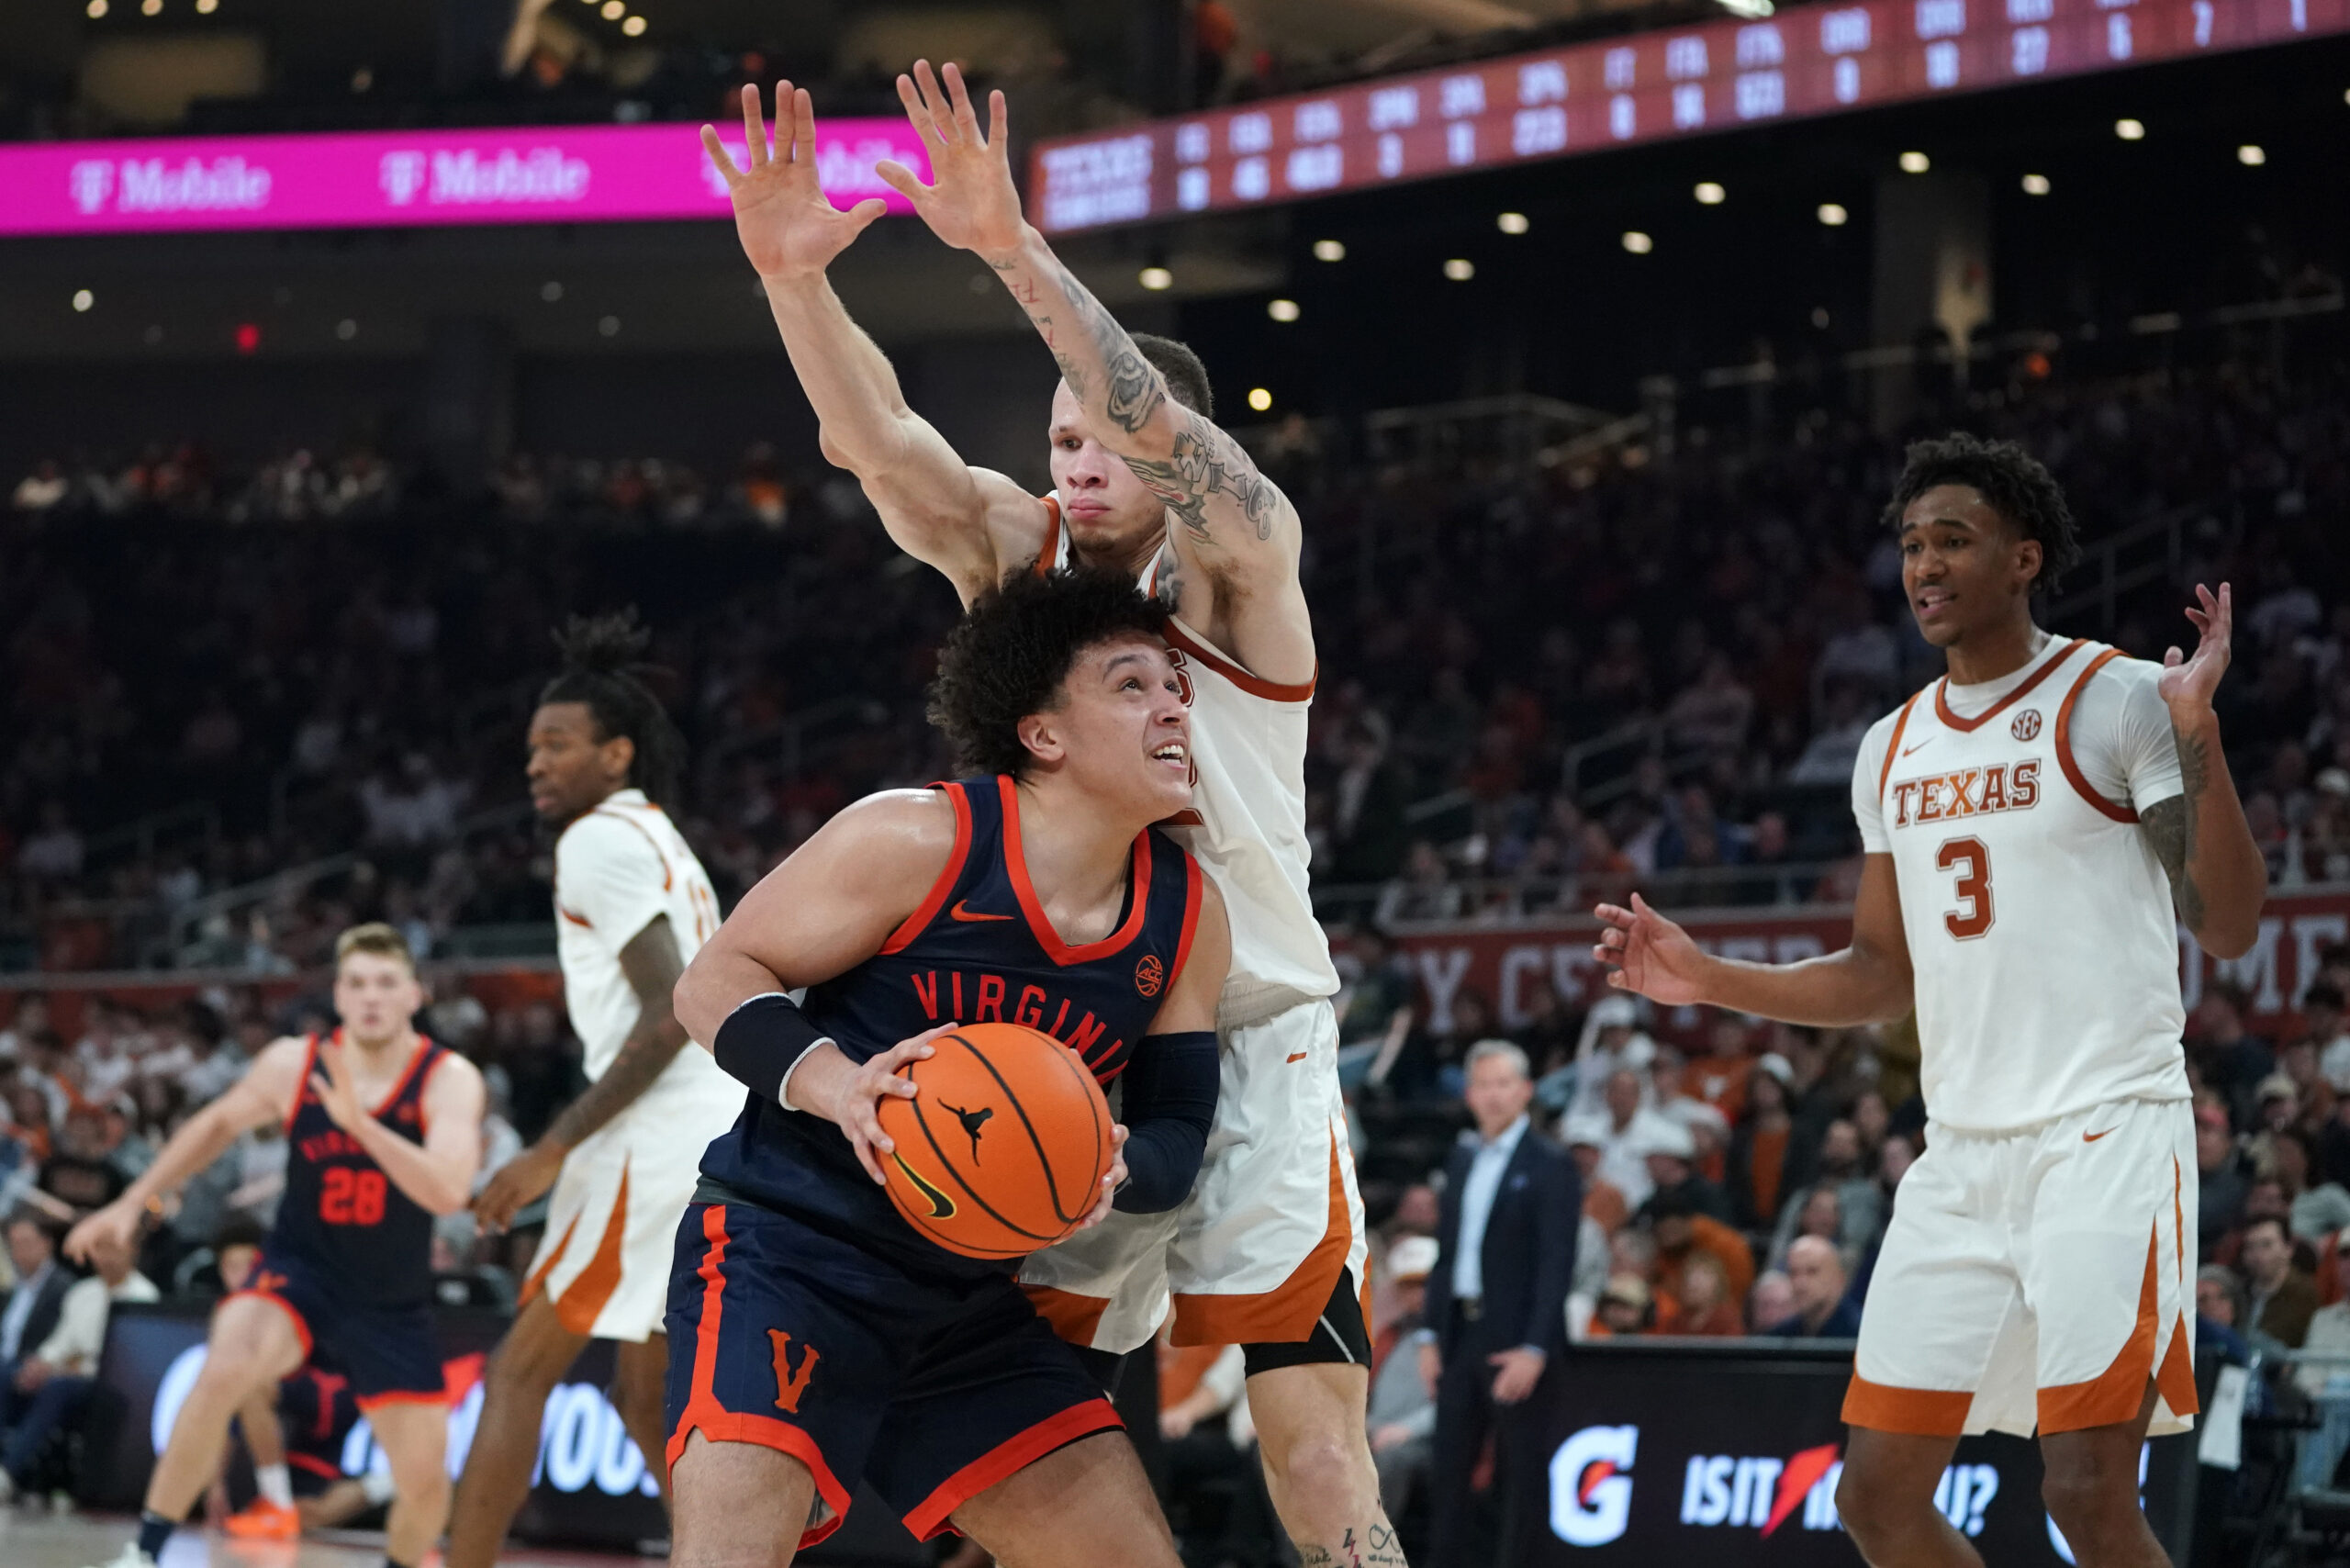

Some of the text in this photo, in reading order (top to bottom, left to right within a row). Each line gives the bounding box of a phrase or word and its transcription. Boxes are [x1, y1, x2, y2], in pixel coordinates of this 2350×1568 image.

[118, 156, 273, 212] Mobile
[430, 148, 591, 203] Mobile
[2012, 710, 2042, 741] SEC
[1893, 757, 2042, 829] TEXAS
[1935, 834, 1996, 942] 3
[1138, 967, 1162, 983] ACC
[320, 1166, 387, 1226] 28
[767, 1328, 821, 1415] V
[1549, 1424, 1639, 1548] G
